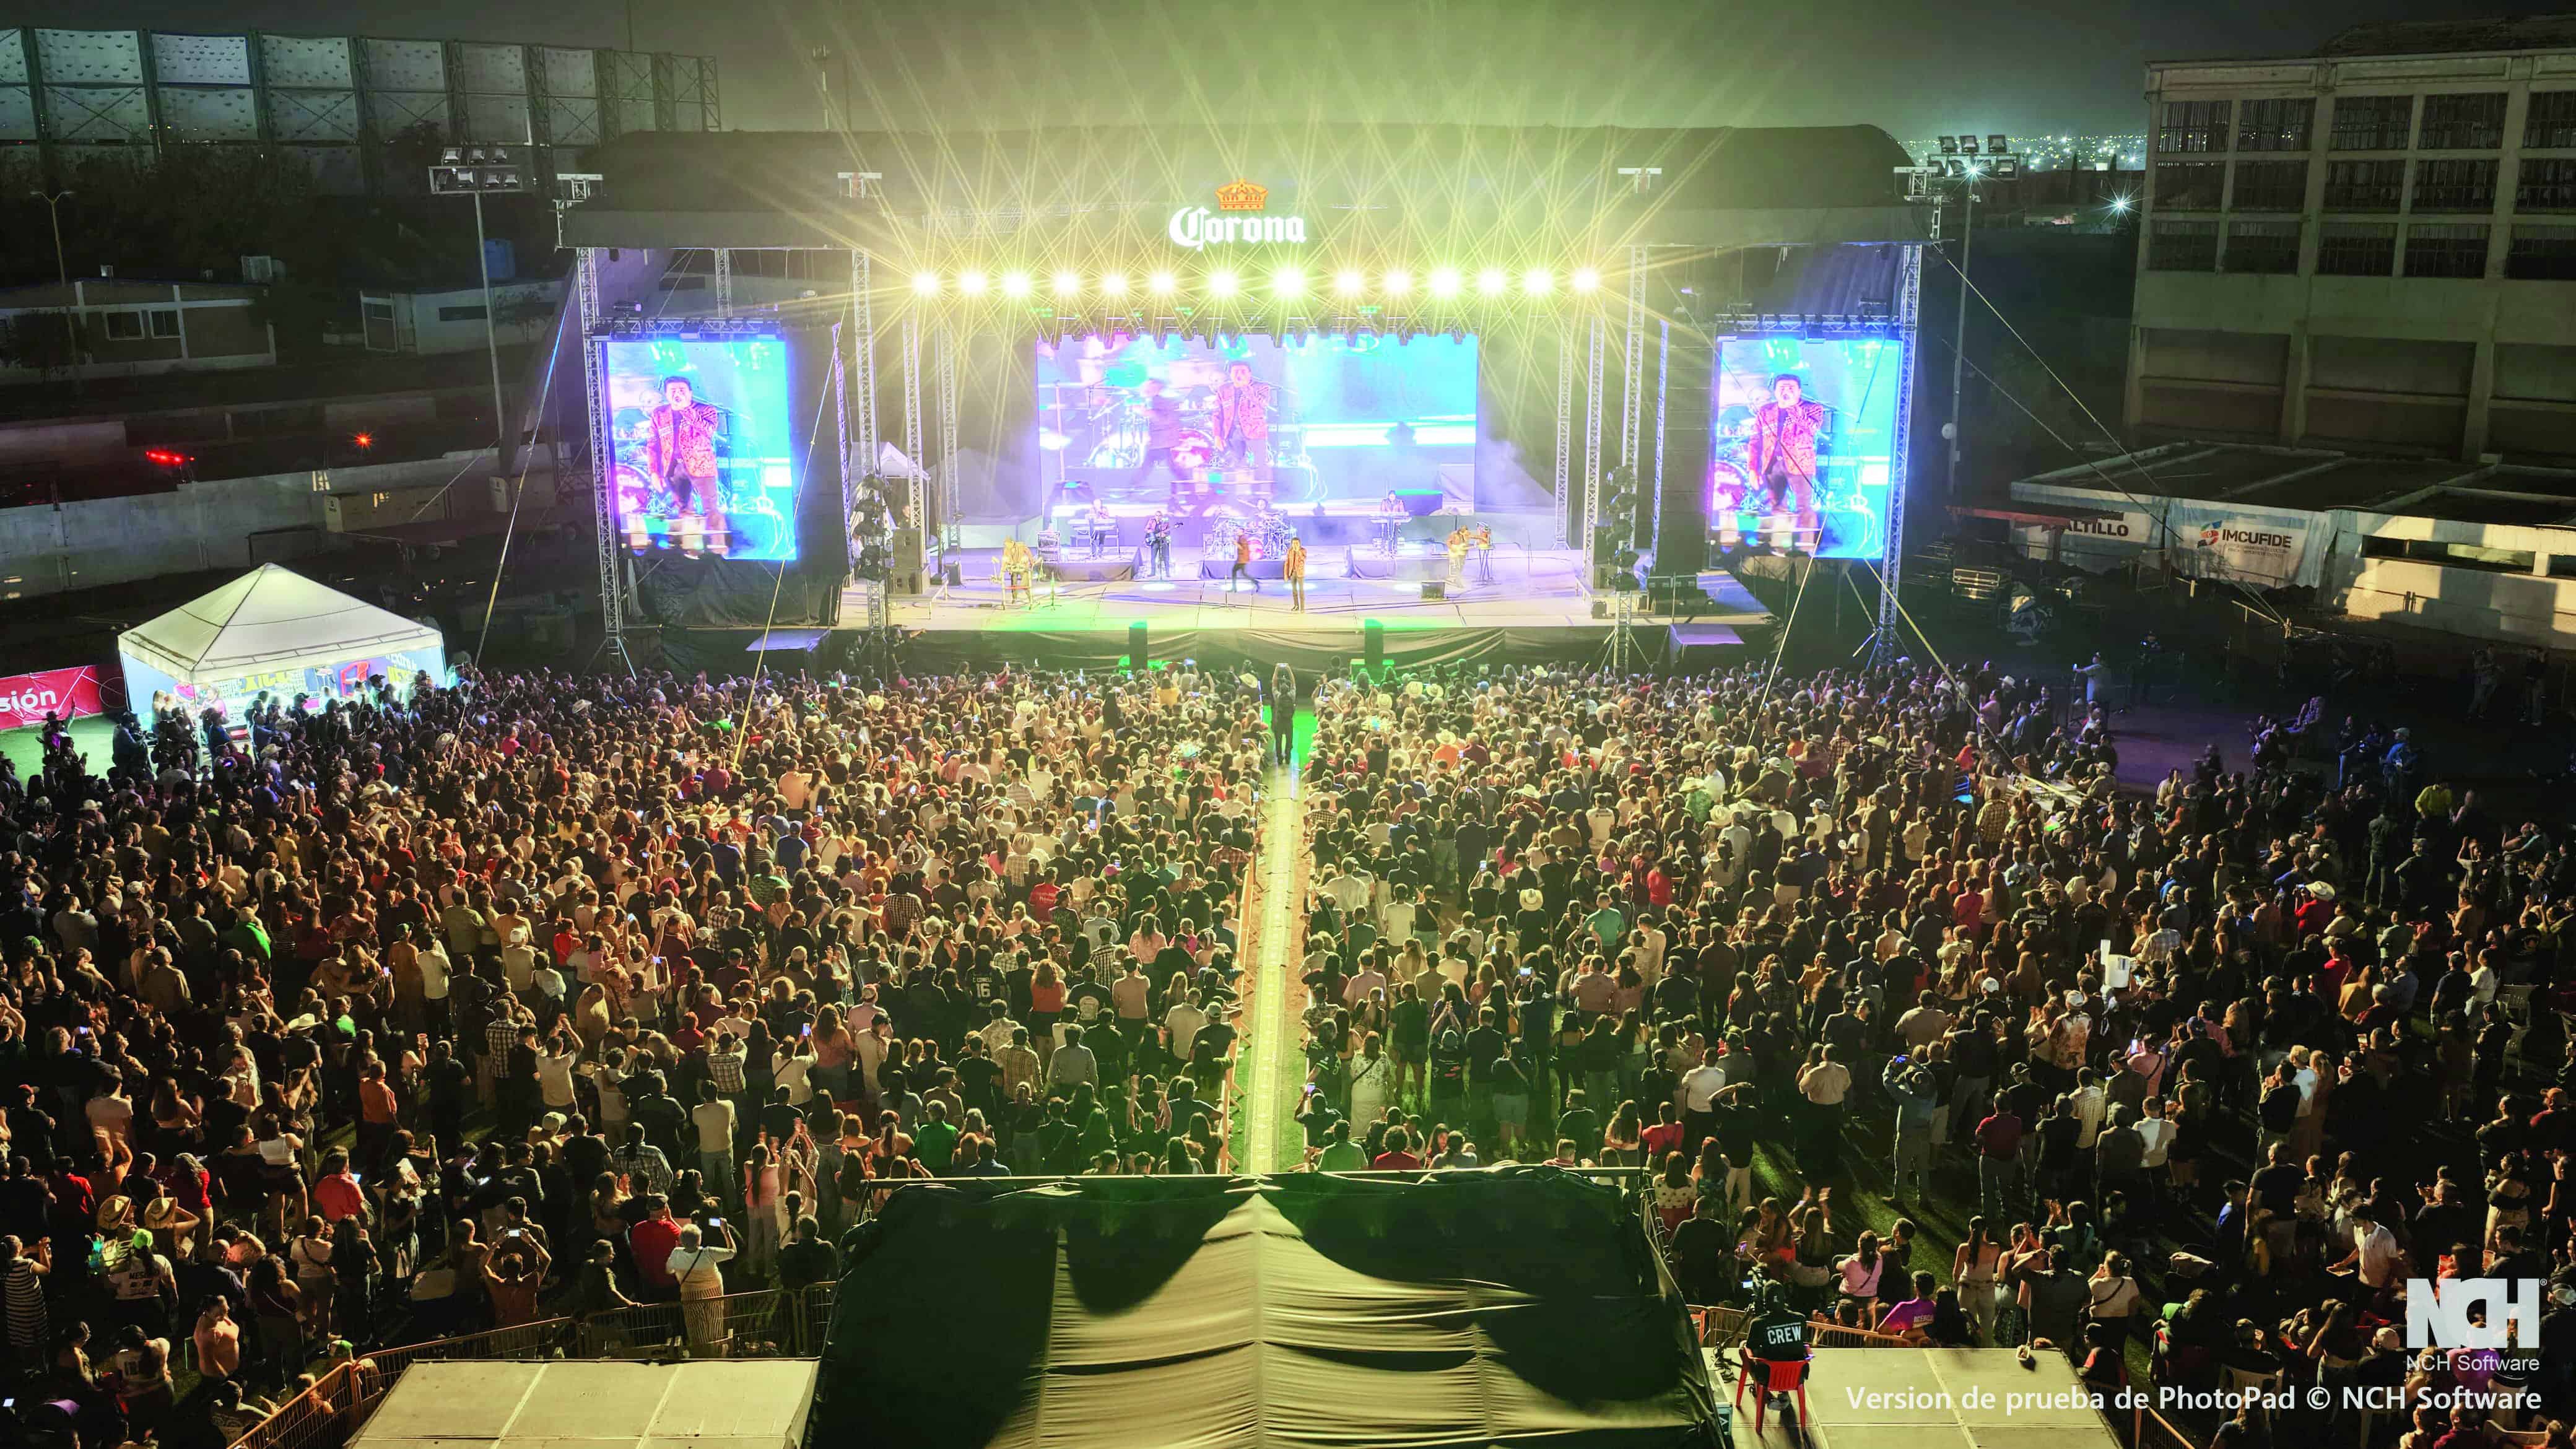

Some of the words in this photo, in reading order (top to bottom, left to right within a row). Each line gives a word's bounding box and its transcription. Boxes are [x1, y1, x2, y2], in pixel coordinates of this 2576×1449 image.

[1168, 206, 1307, 251] Corona
[2222, 529, 2293, 548] IMCUFIDE
[0, 688, 57, 713] sión
[976, 983, 991, 998] 16
[1767, 1325, 1803, 1346] CREW
